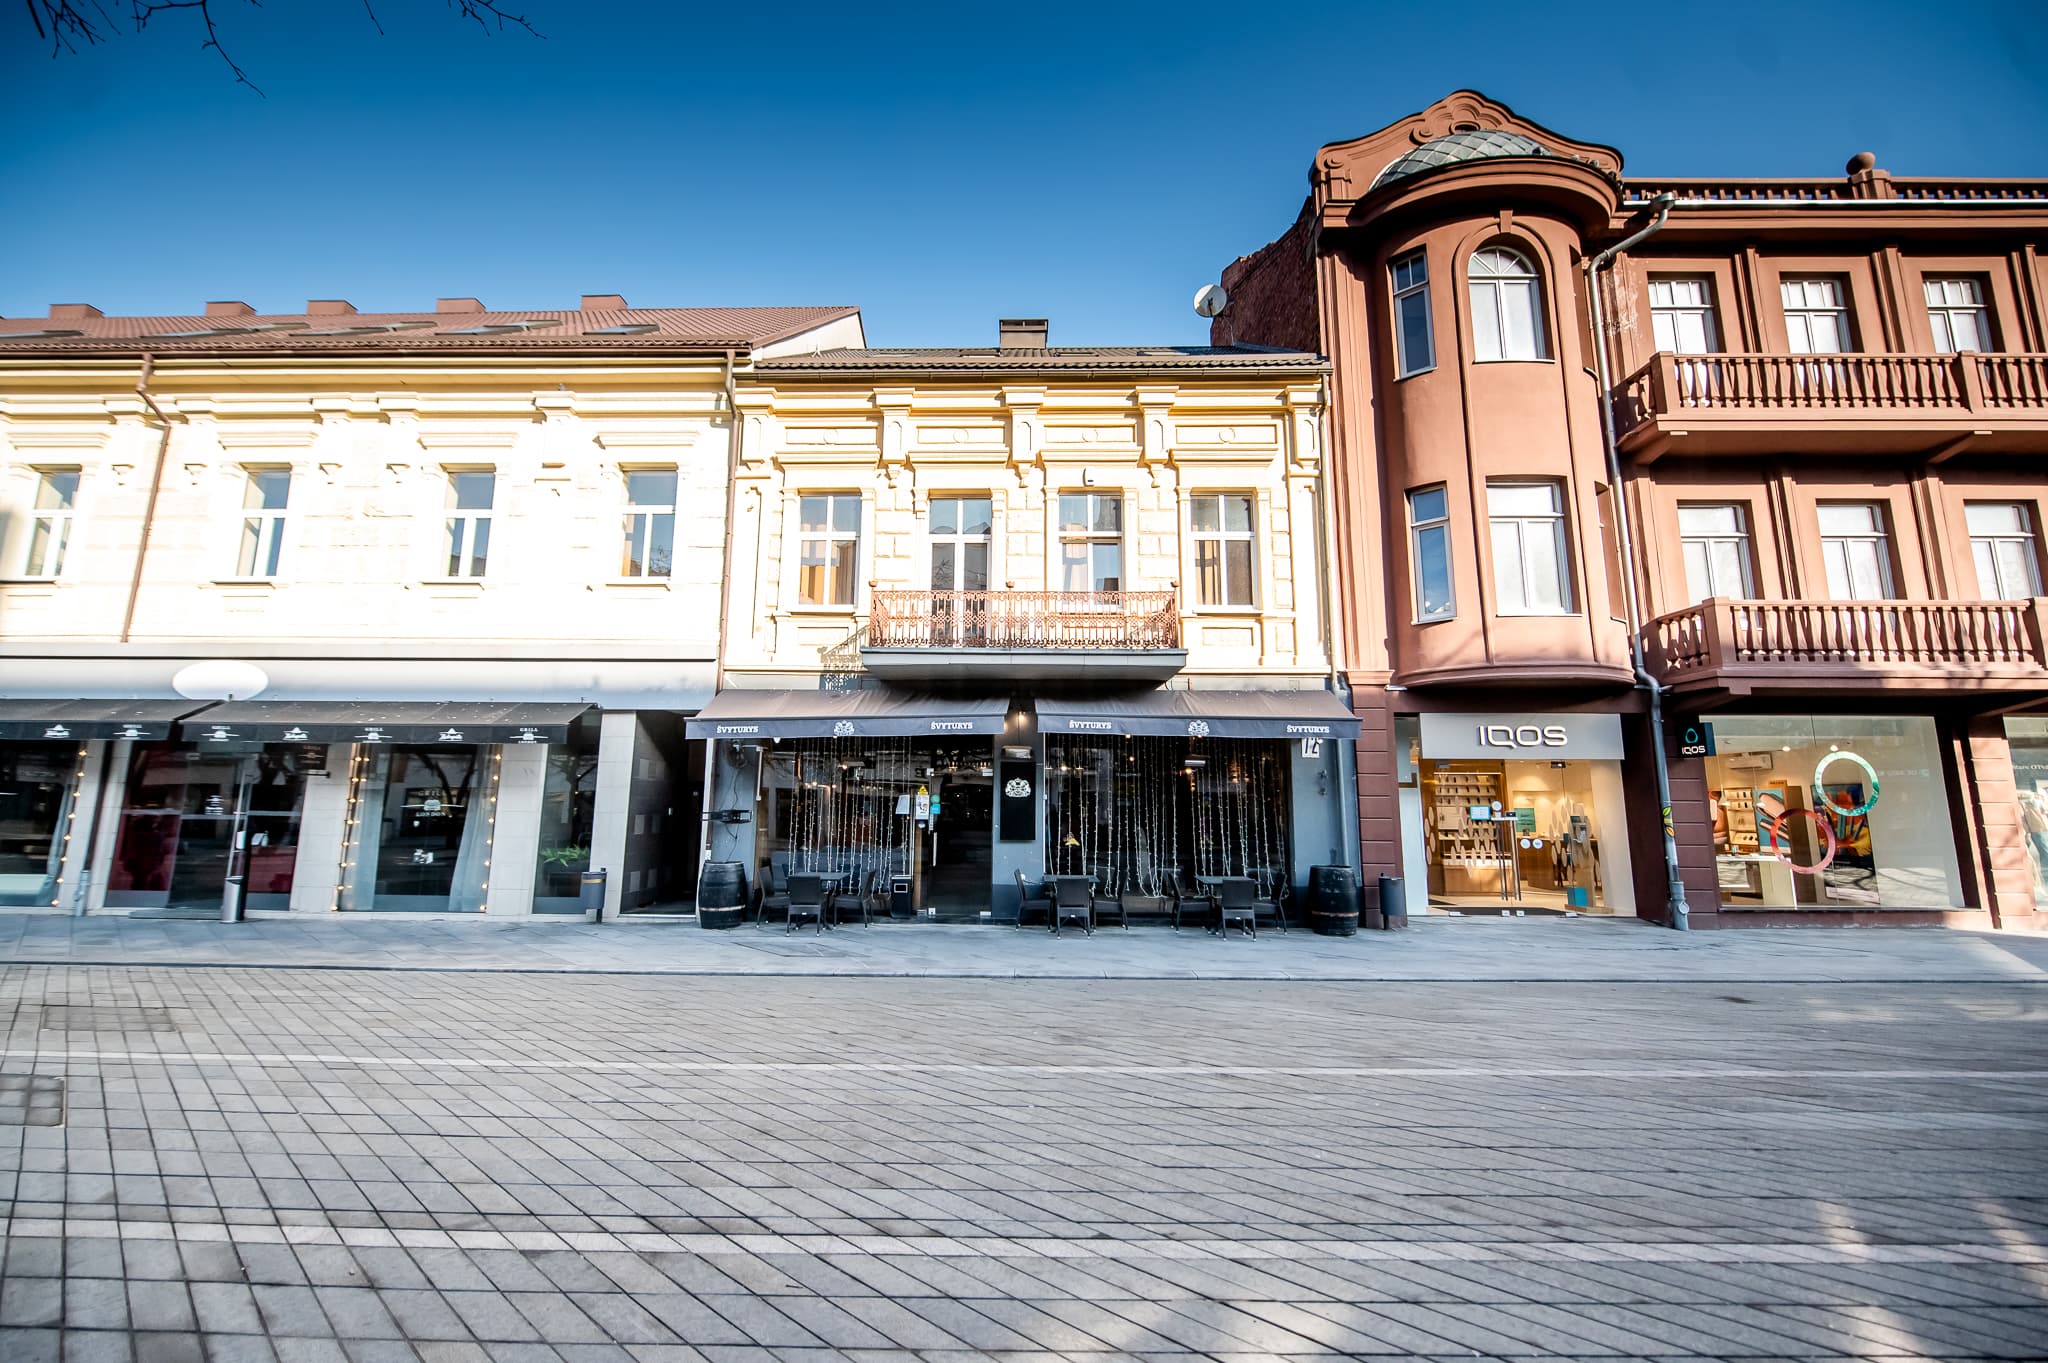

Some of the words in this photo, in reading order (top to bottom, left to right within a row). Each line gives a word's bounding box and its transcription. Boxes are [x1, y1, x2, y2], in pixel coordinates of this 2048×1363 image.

[716, 724, 759, 734] ŠVYTURYS
[930, 721, 974, 731] ŠVYTURYS
[1068, 719, 1112, 729] ŠVYTURYS
[1286, 723, 1330, 734] ŠVYTURYS
[1478, 725, 1568, 749] IQOS
[1681, 745, 1706, 755] IQOS
